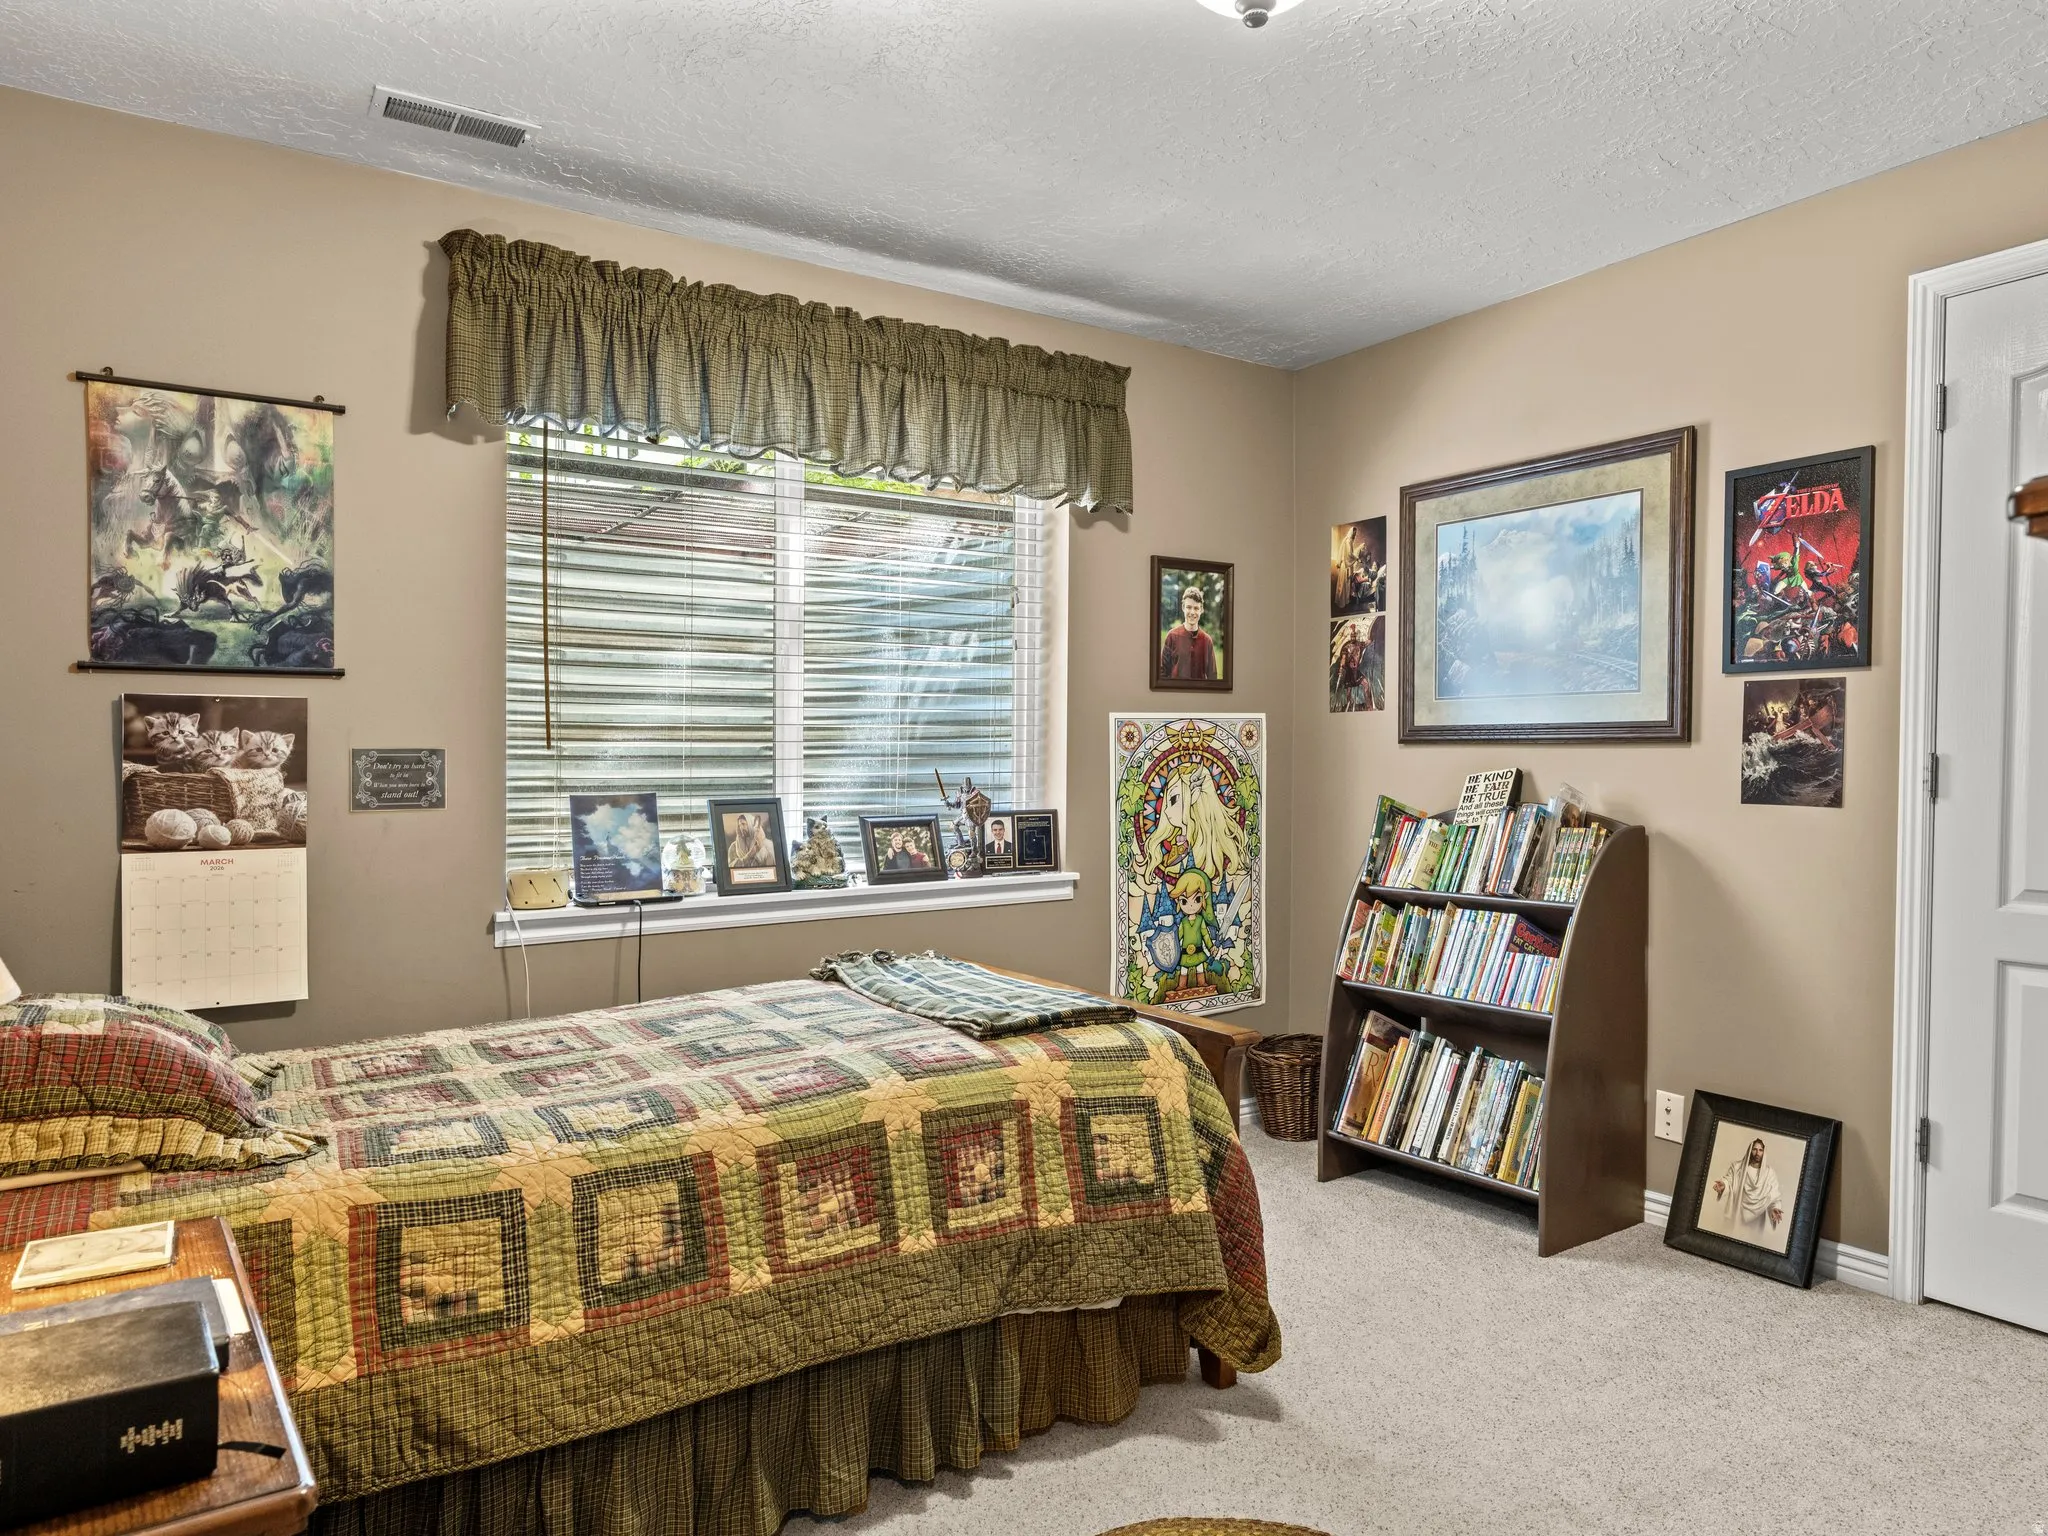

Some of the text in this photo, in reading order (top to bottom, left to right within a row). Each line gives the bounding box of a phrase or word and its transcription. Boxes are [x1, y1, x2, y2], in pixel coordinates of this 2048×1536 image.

[1757, 487, 1848, 529] ZELDA
[373, 762, 393, 770] Don't
[393, 763, 401, 771] try
[1468, 770, 1514, 785] BE KIND
[381, 790, 419, 799] stand out!
[1465, 780, 1510, 795] BE FAIR
[1462, 790, 1508, 804] BE TRUE
[1458, 801, 1504, 812] And all these
[1456, 810, 1474, 819] things
[200, 858, 234, 866] MARCH
[1513, 935, 1524, 946] FAT
[1524, 942, 1536, 954] CAT
[1516, 922, 1560, 958] Garfield
